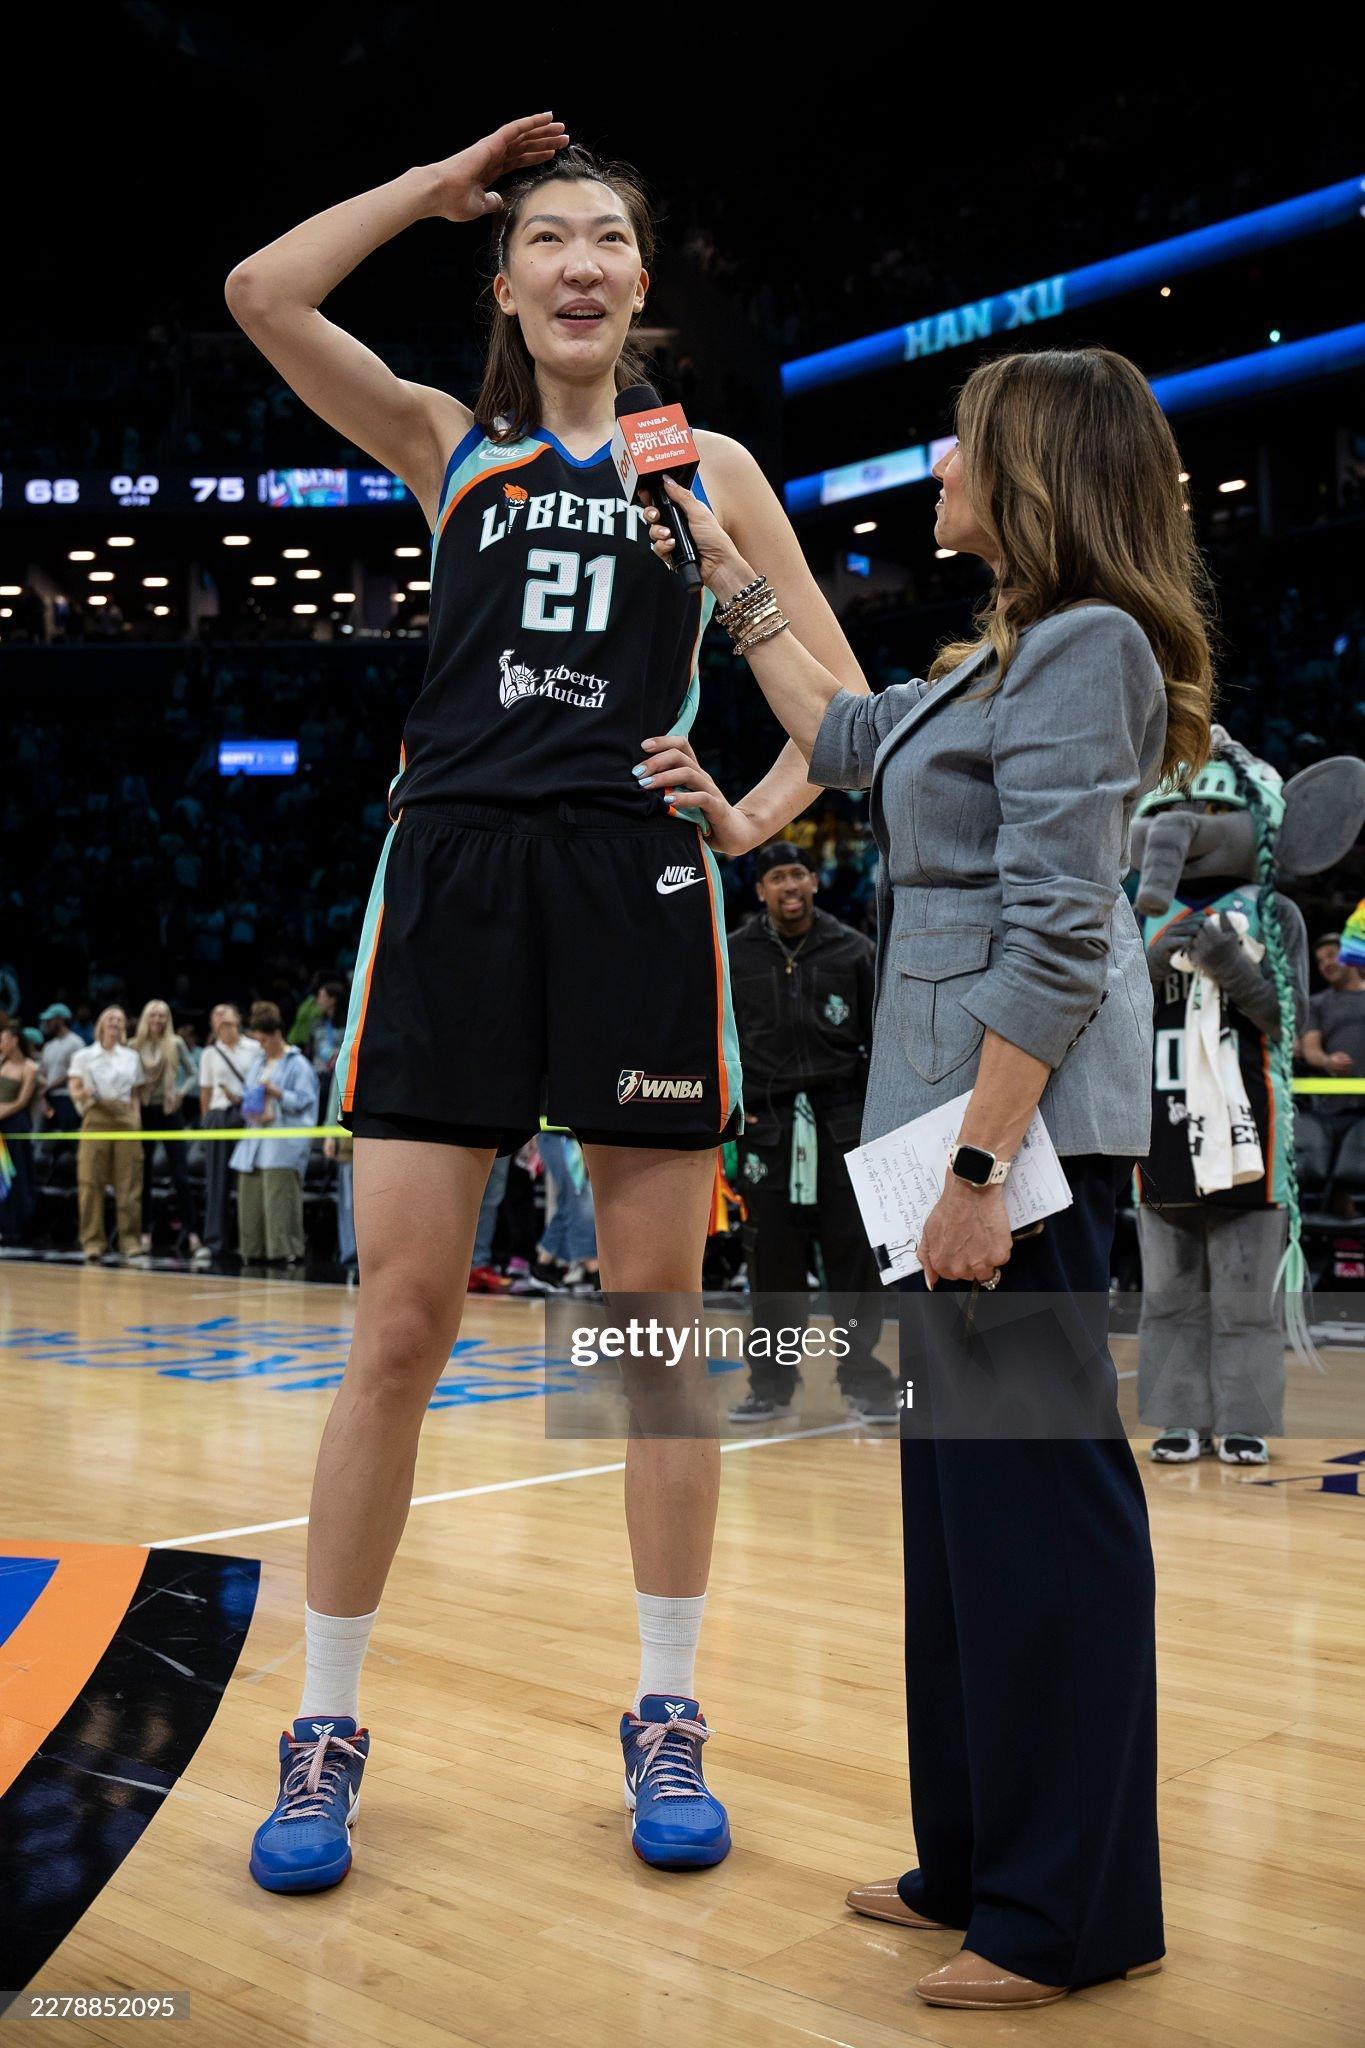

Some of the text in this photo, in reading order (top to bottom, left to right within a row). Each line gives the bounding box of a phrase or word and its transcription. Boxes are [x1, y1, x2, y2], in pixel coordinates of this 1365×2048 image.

[904, 276, 1065, 361] HAN XU
[634, 424, 678, 441] FRIDAY NIGHT
[637, 416, 669, 428] WNBA
[488, 446, 523, 457] NIKE
[630, 430, 690, 457] SPOTLIGHT
[25, 479, 80, 504] 68
[110, 475, 160, 495] 0.0
[190, 477, 245, 502] 75
[521, 548, 616, 632] 21
[542, 664, 610, 697] Liberty
[537, 680, 607, 708] Mutual
[663, 866, 697, 883] NIKE
[642, 1079, 703, 1099] WNBA
